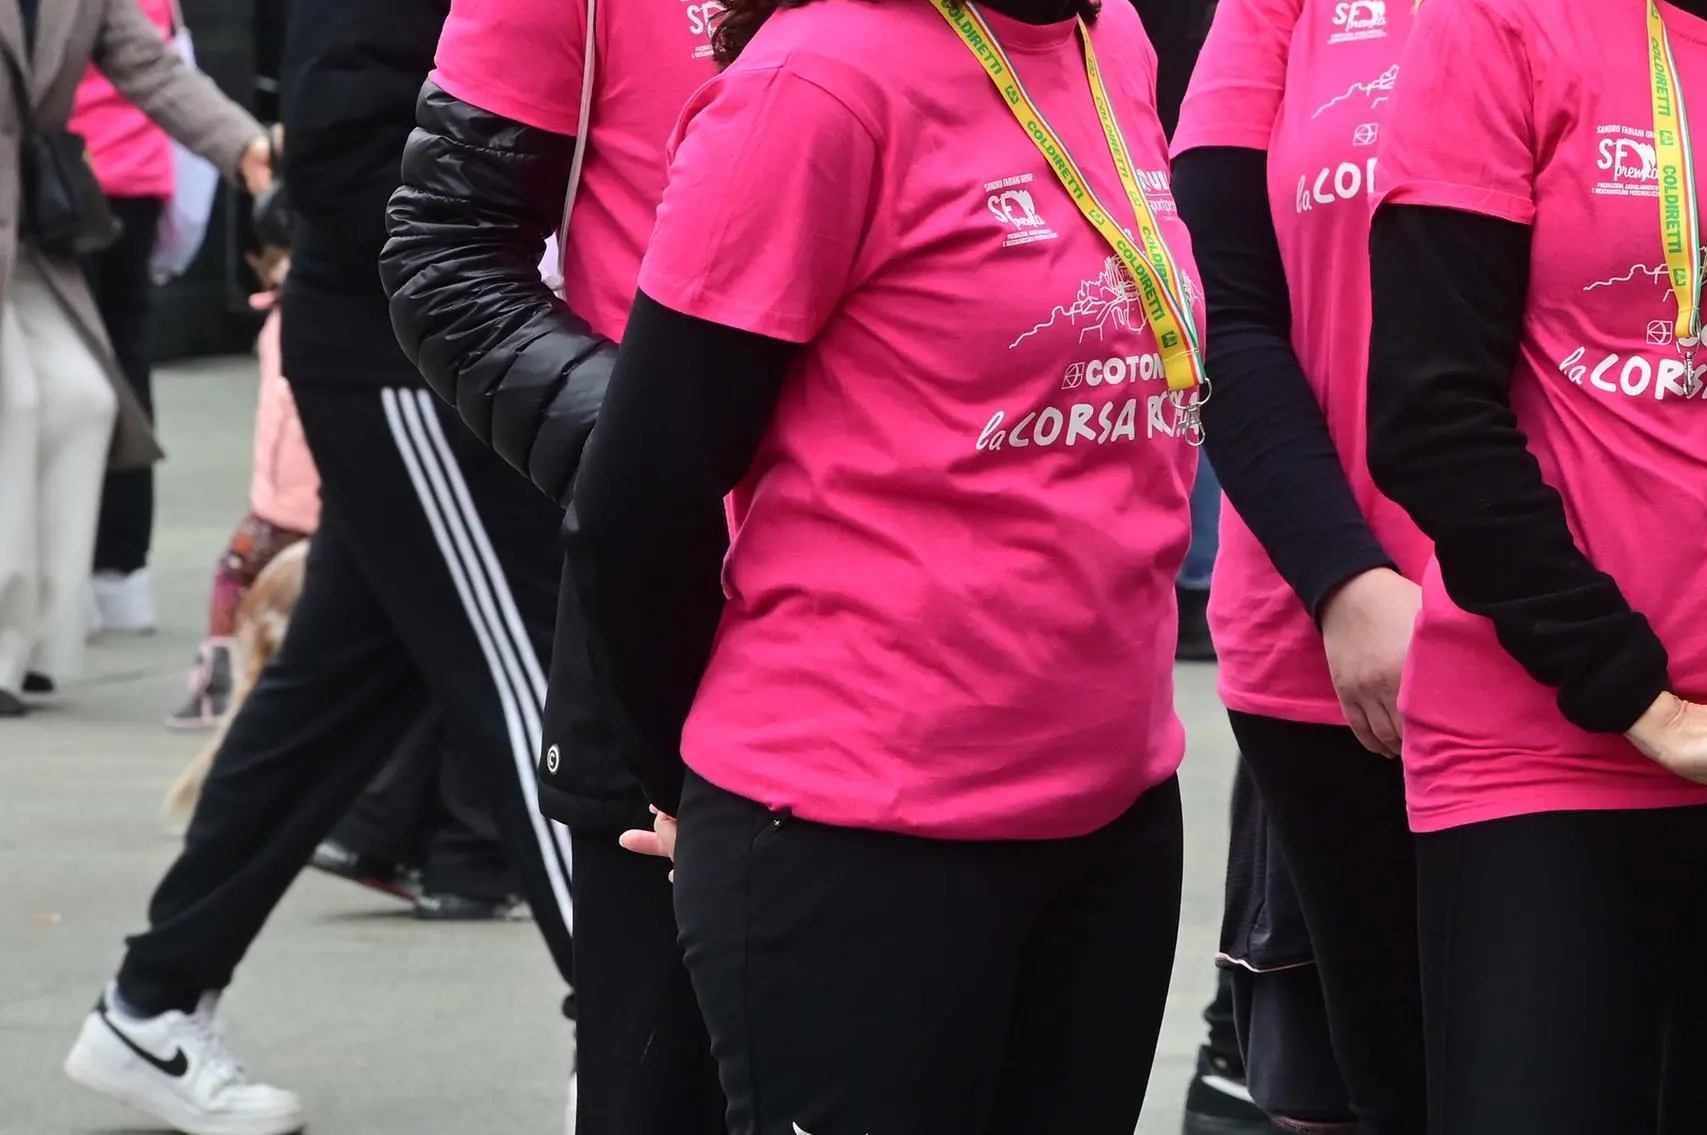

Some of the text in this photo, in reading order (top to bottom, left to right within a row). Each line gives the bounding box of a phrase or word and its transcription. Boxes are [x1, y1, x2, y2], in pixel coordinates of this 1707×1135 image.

[1651, 37, 1671, 116] COLDIRETTI
[1027, 120, 1083, 199] COLDIRETTI
[1662, 165, 1683, 254] COLDIRETTI
[1116, 240, 1165, 321] COLDIRETTI
[975, 410, 1006, 451] la
[1008, 398, 1136, 447] CORSA
